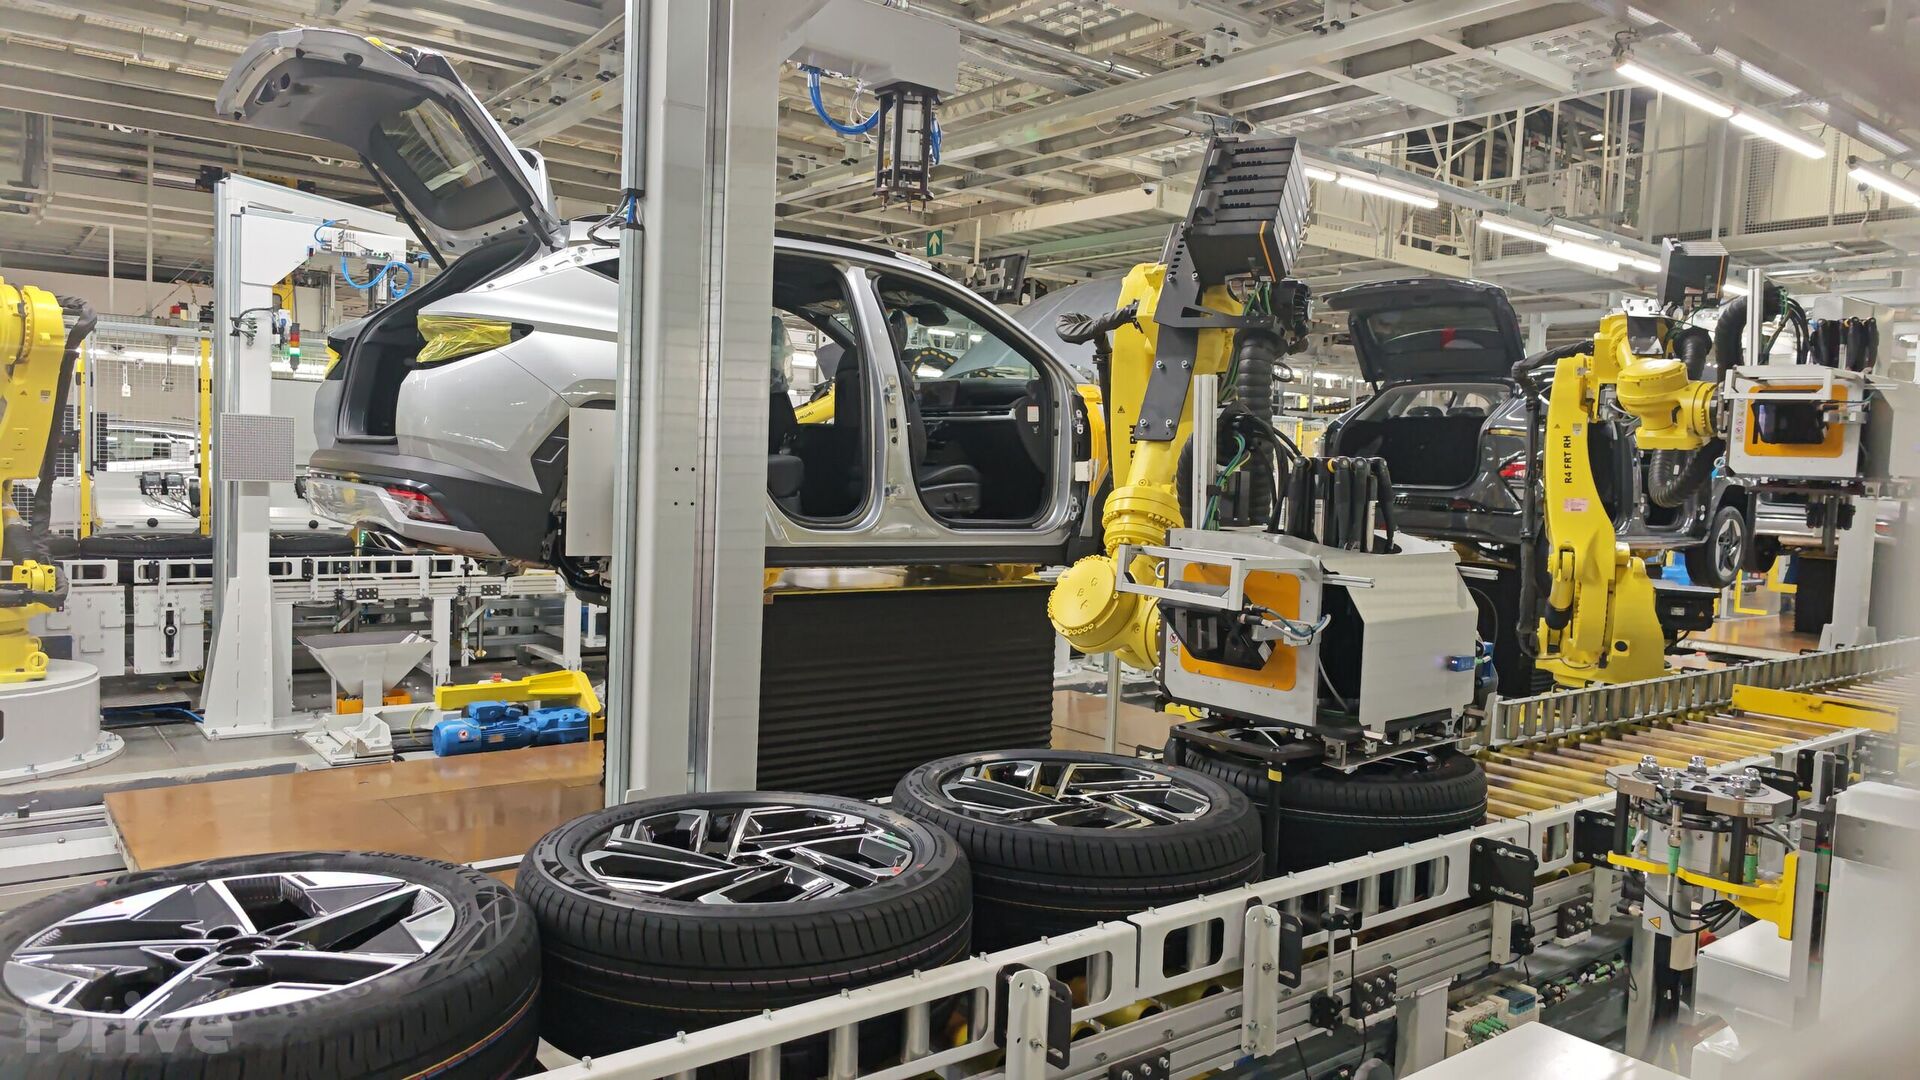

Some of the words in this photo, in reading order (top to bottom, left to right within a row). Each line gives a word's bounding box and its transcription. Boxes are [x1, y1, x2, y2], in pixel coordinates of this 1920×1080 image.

[1563, 435, 1571, 448] RH
[1564, 452, 1572, 469] FRT
[1564, 472, 1572, 484] R4
